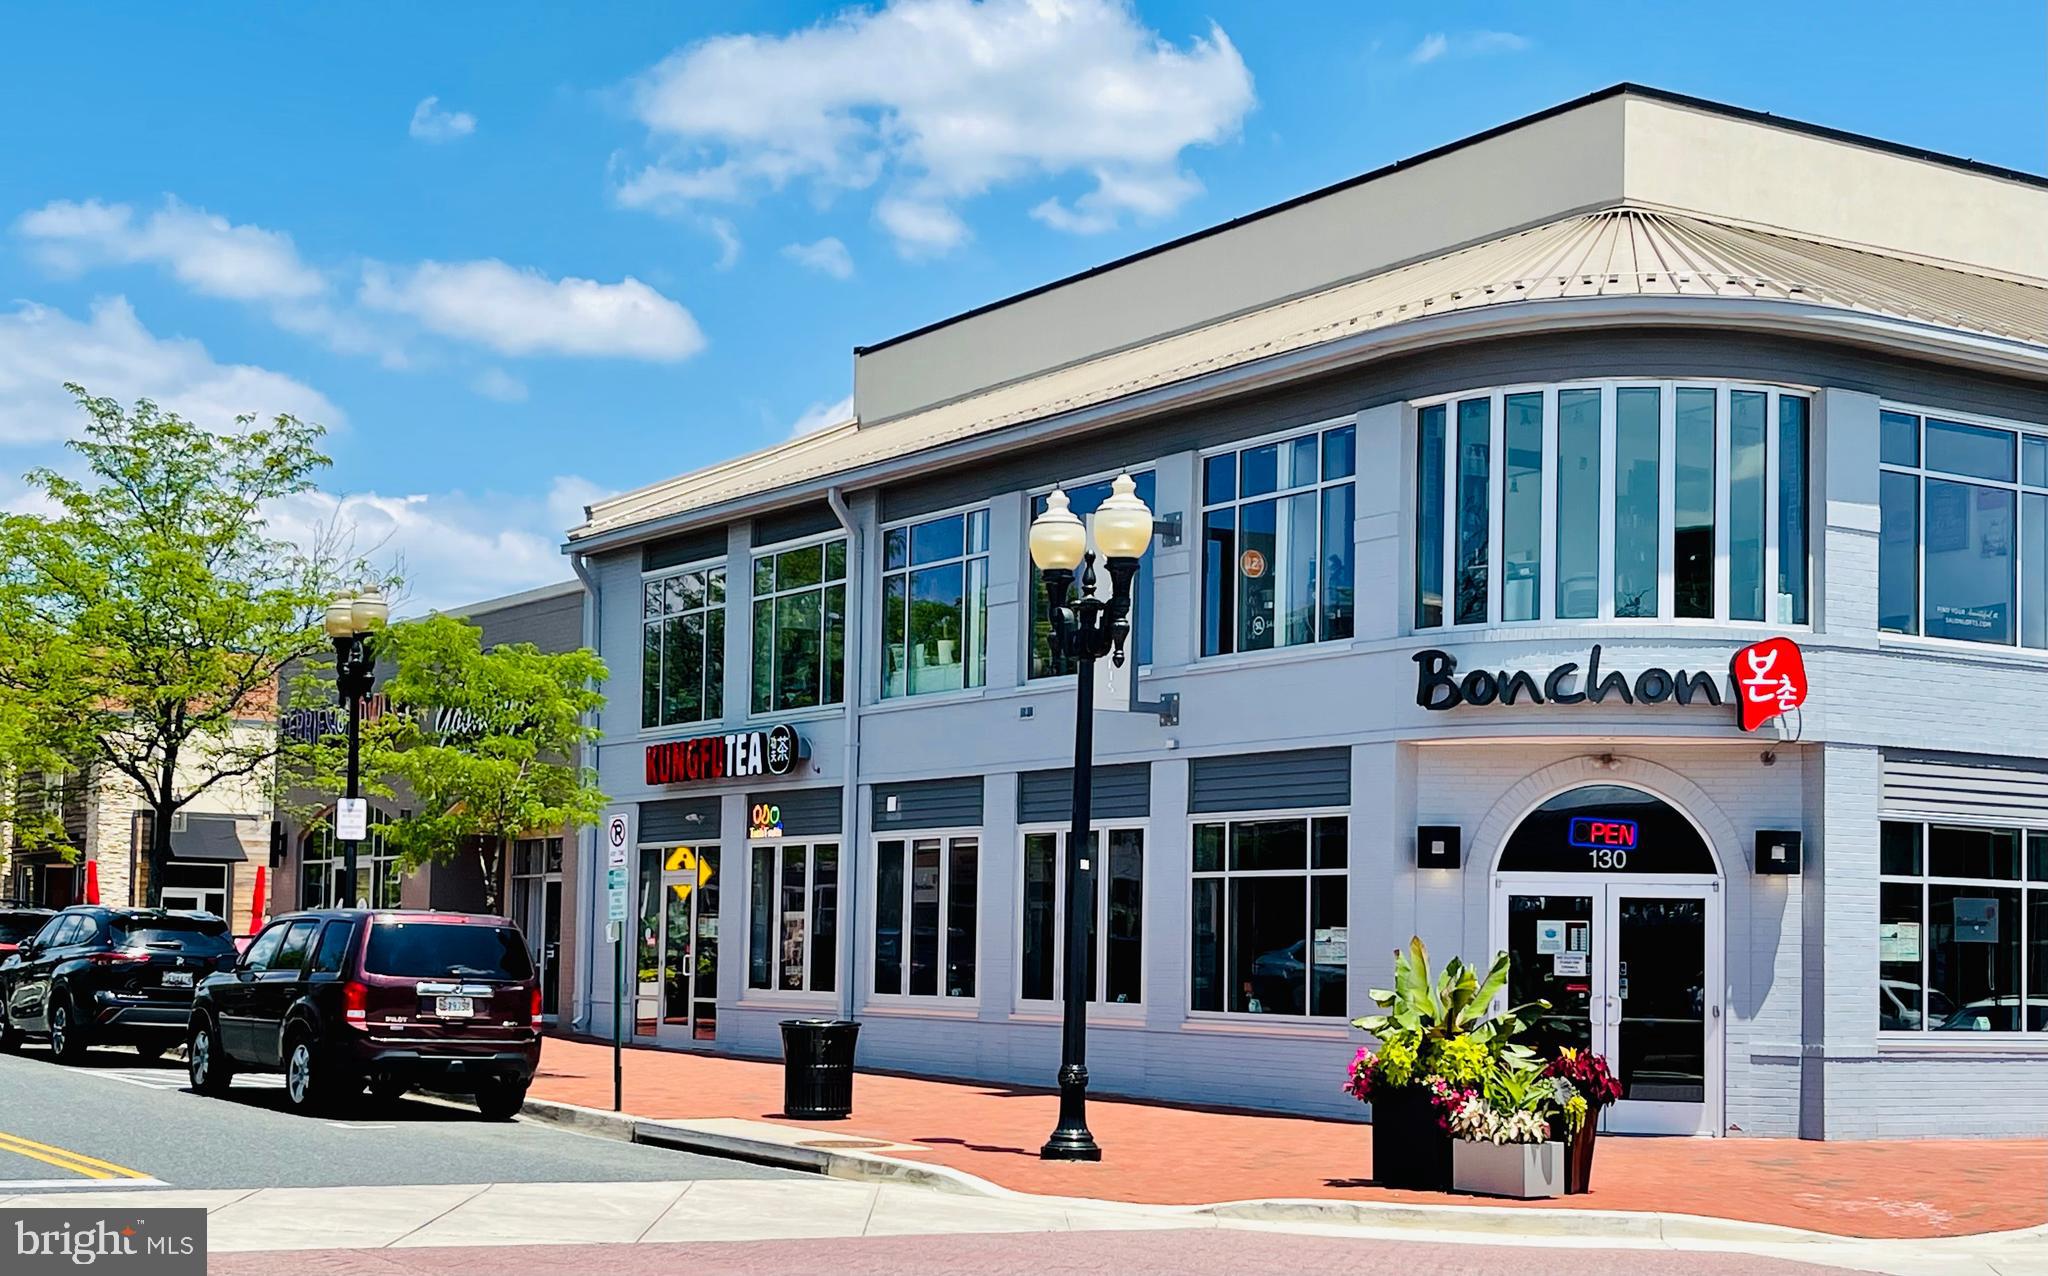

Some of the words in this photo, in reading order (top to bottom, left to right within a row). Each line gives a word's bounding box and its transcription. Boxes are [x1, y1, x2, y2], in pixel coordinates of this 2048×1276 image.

[1412, 644, 1722, 711] Bonchon
[1742, 648, 1797, 711] 본촌
[725, 731, 764, 777] TEA
[1588, 849, 1627, 869] 130
